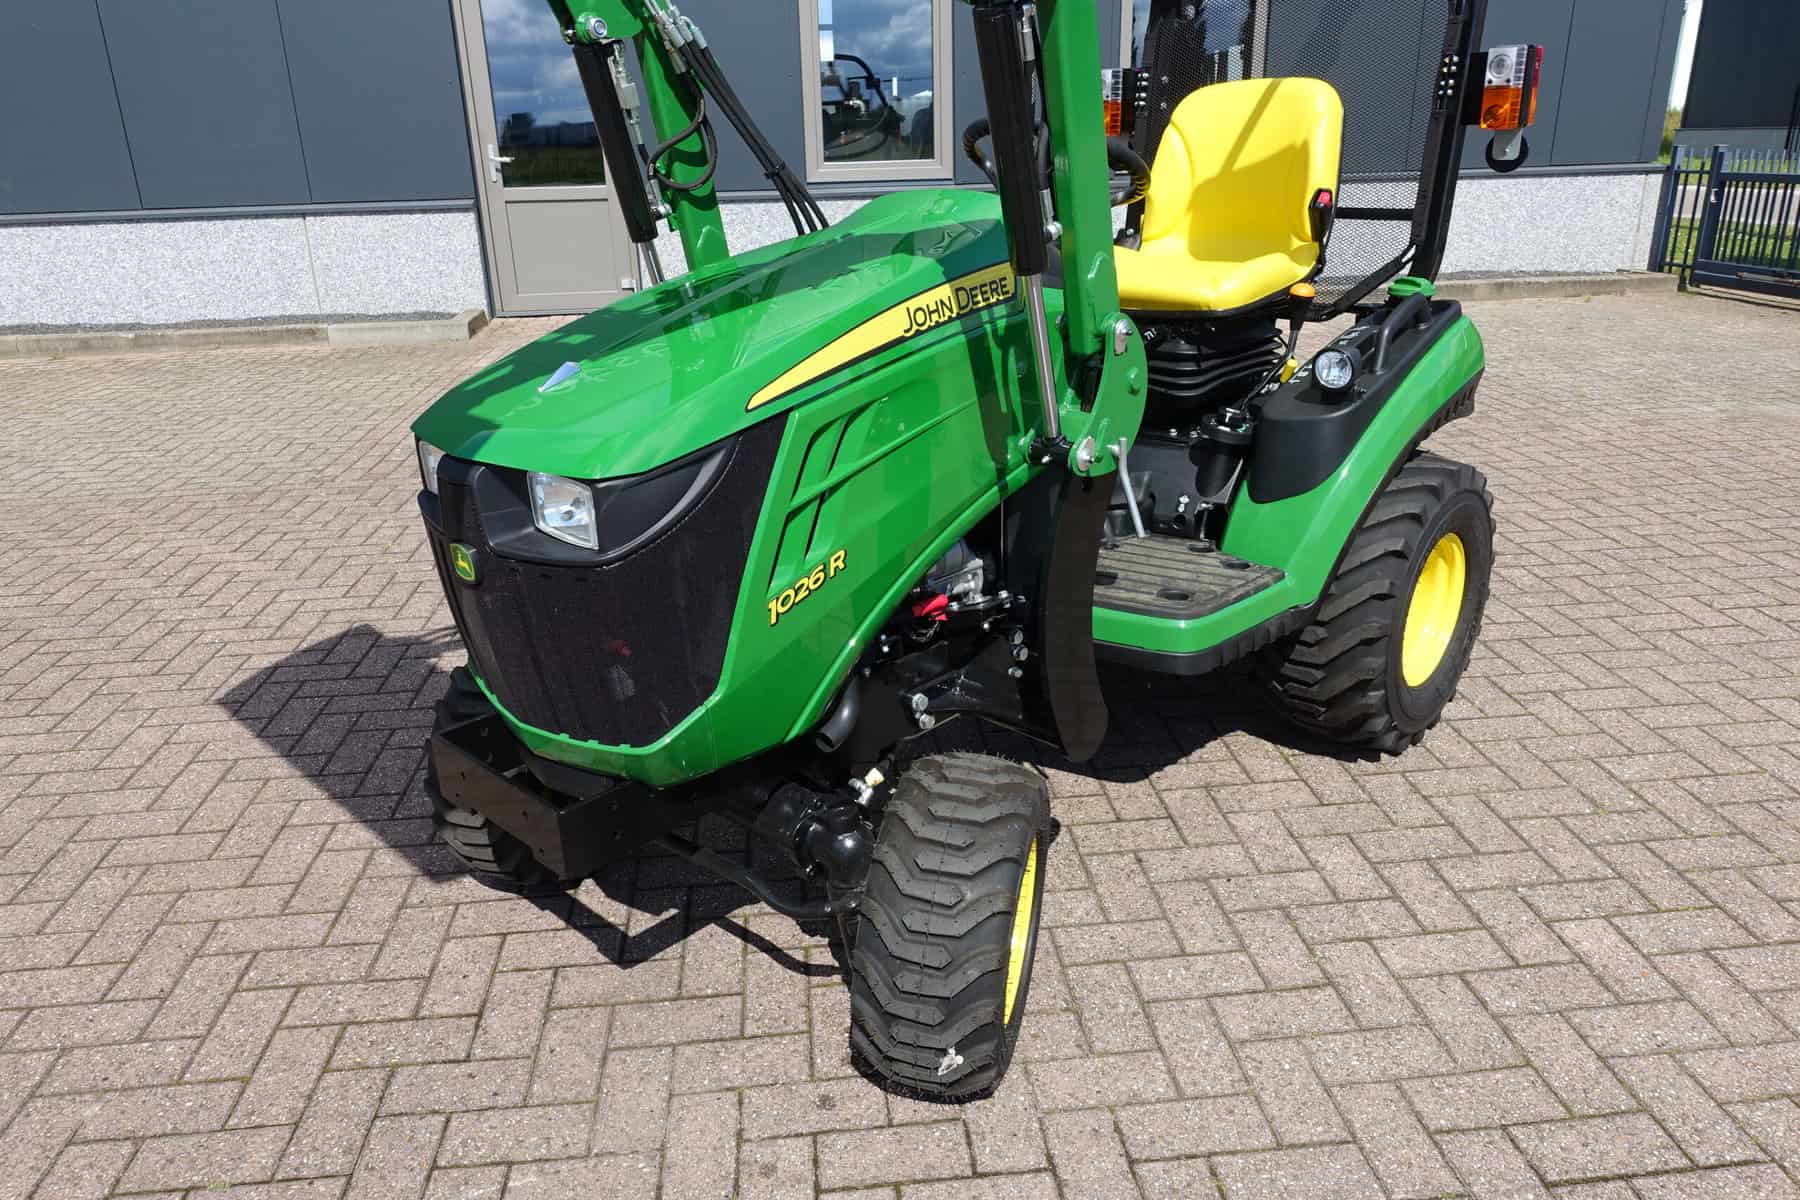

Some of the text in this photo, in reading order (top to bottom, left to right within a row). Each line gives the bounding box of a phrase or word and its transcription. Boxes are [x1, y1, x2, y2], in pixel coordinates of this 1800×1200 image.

[903, 276, 1010, 334] JOHN DEERE
[768, 549, 847, 626] 1026 R
